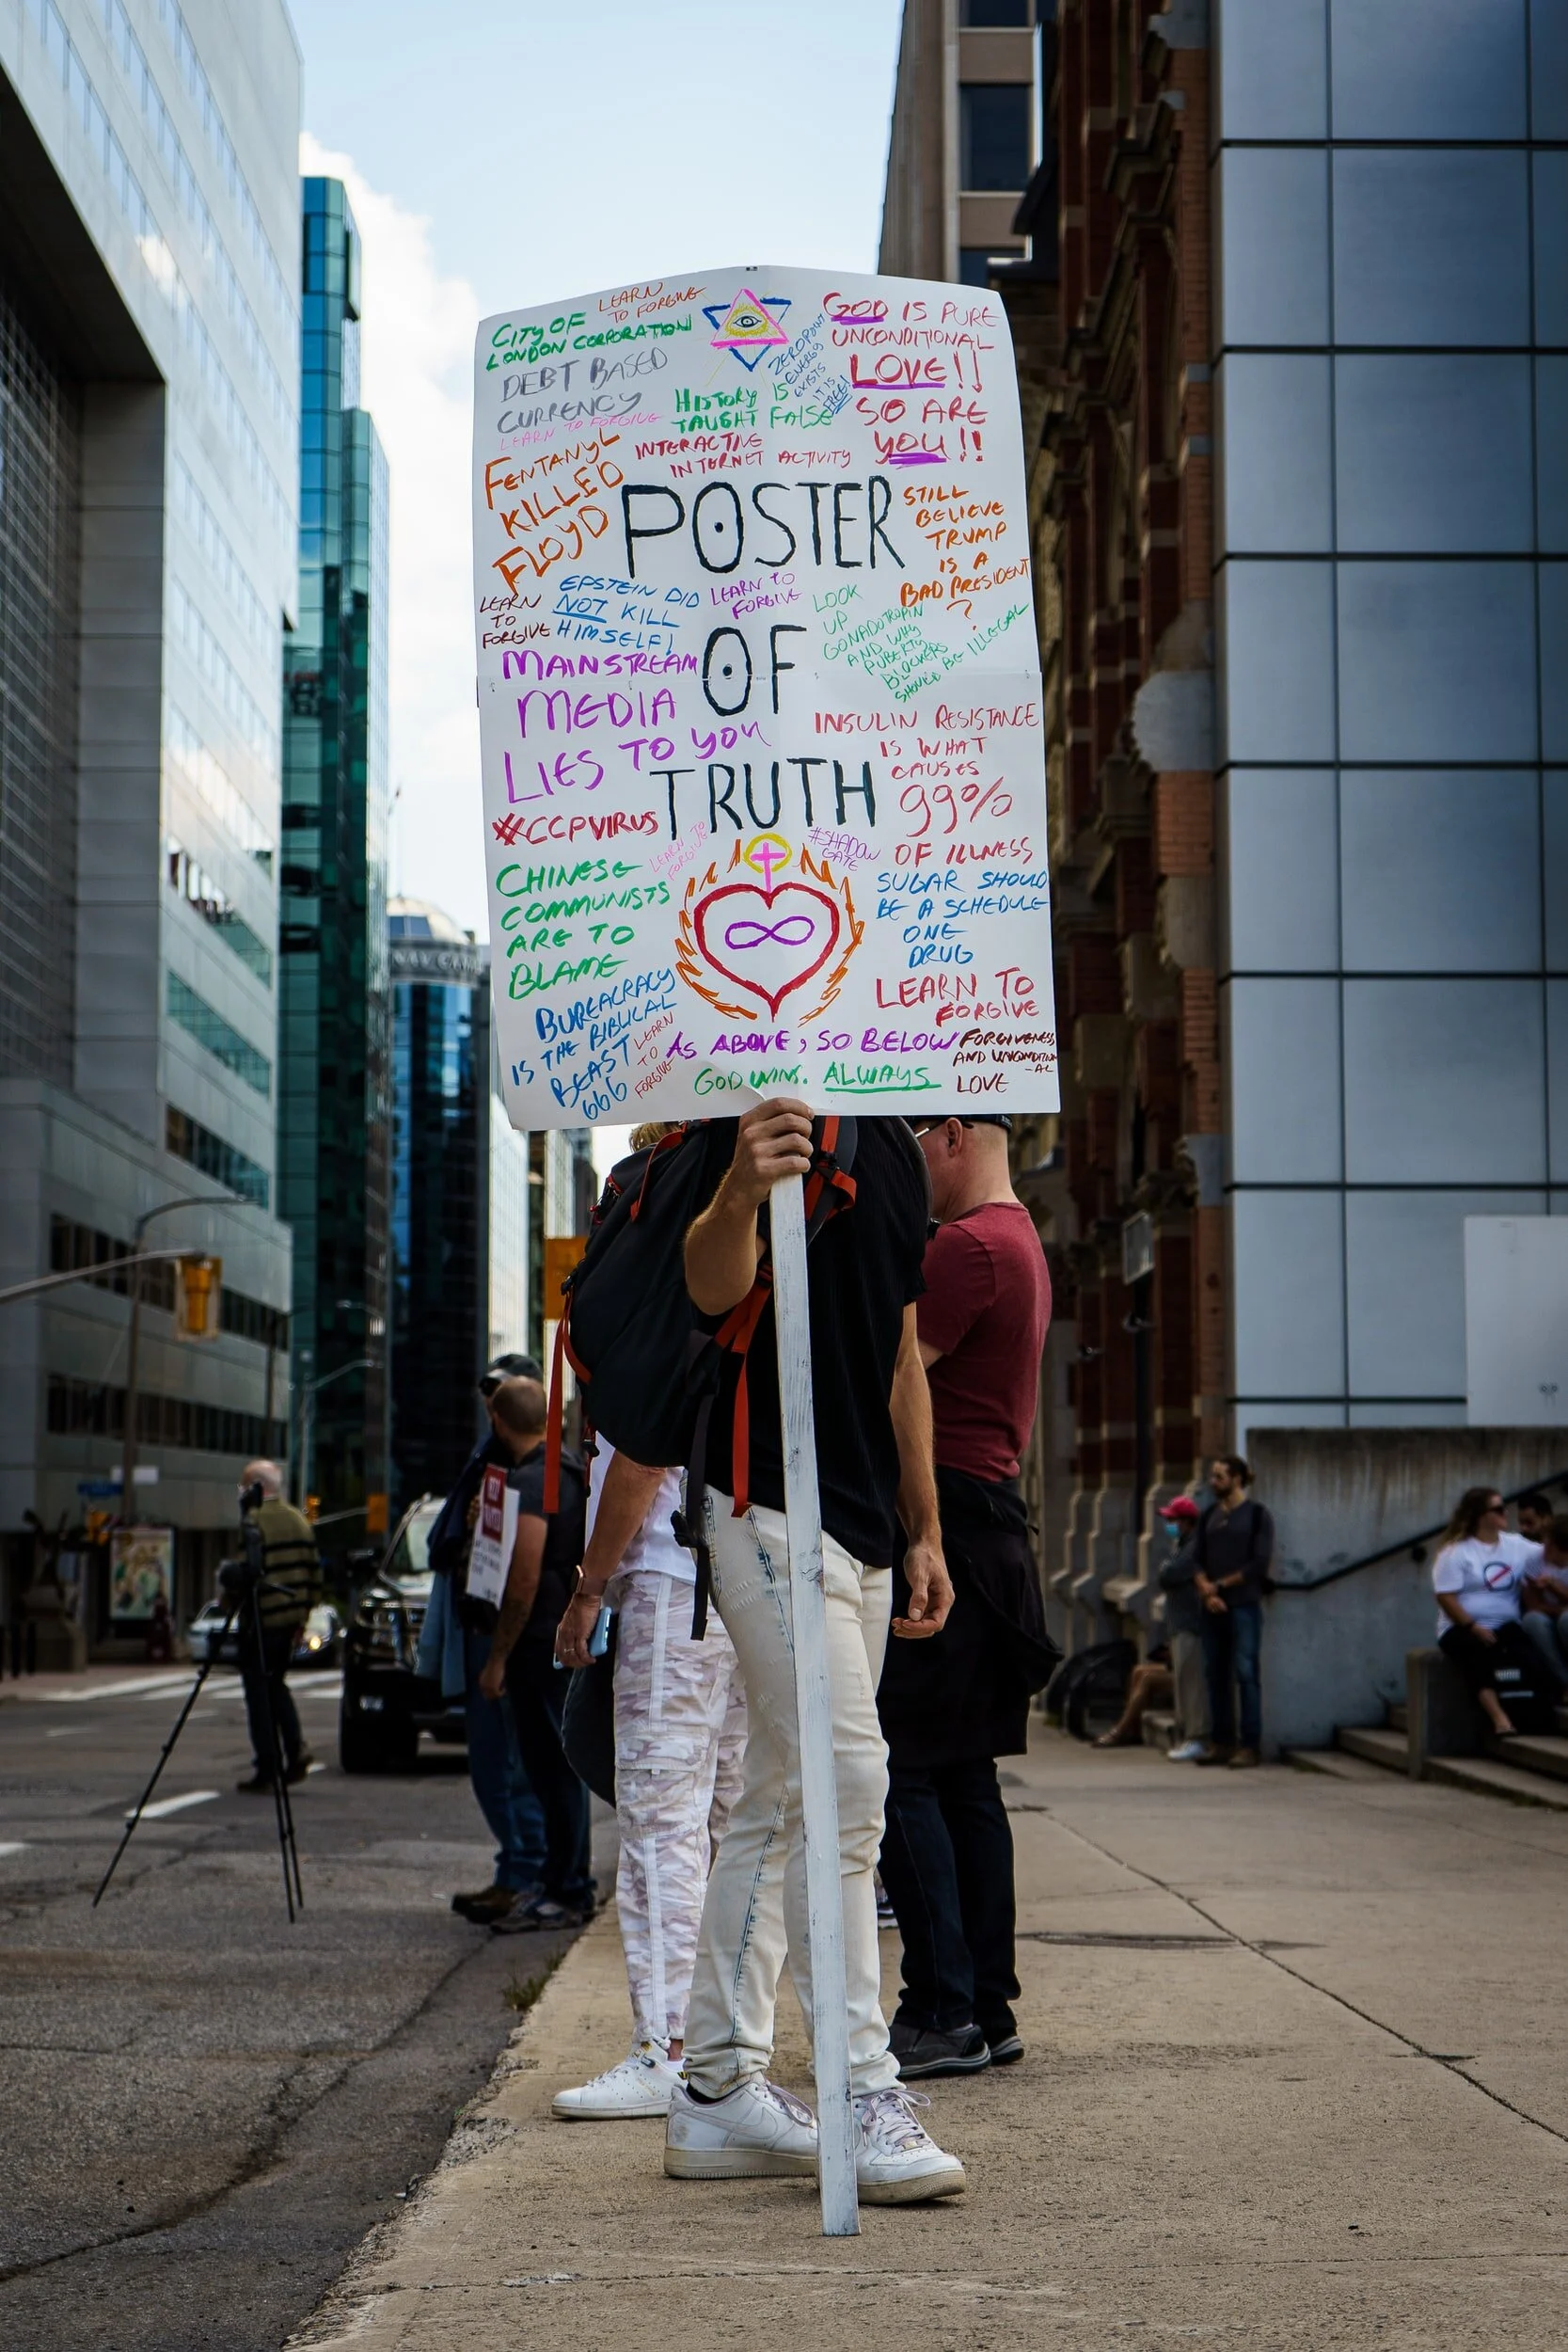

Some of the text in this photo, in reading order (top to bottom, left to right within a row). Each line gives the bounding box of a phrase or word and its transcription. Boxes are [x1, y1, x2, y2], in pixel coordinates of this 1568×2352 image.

[599, 281, 663, 312] LEARN
[608, 286, 707, 324] TO FORGIVE
[823, 292, 1000, 327] GOD IS PURE
[485, 313, 692, 372] LONDON CORPORATION
[492, 311, 587, 348] CITY OF
[832, 326, 994, 349] UNCONDITIONAL
[500, 346, 668, 403] DEBT BASED
[784, 342, 824, 384] ENERGY
[674, 382, 789, 414] HISTORY IS
[794, 365, 826, 397] EXISTS
[813, 377, 836, 402] IT IS
[497, 392, 642, 434] CURRENCY
[670, 405, 834, 434] TAUGHT FALSE
[856, 396, 989, 426] SO ARE
[500, 413, 663, 452] LEARN TO FORGIVE
[635, 432, 763, 460] INTERACTIVE
[484, 428, 620, 510] FENTANYL
[670, 450, 851, 478] INTERNET ACTIVITY
[499, 461, 625, 540] KILLED
[902, 485, 970, 507] STILL
[622, 475, 906, 579] POSTER
[915, 501, 1005, 529] BELIEVE
[491, 505, 609, 596] FLOYD
[925, 520, 1007, 551] TRUMP
[939, 551, 989, 574] IS A
[559, 575, 700, 608] EPSTEIN DID
[710, 578, 764, 606] LEARN
[813, 583, 863, 613] LOOK
[900, 558, 1030, 608] BAD PRESIDENT
[480, 594, 542, 612] LEARN
[556, 594, 681, 628] NOT KILL
[732, 589, 802, 620] FORGIVE
[482, 622, 551, 649] FORGIVE
[490, 613, 516, 628] TO
[557, 619, 673, 656] HIMSELF!
[823, 610, 848, 635] UP
[847, 624, 923, 667] AND WHY
[864, 639, 927, 676] PUBERTY
[895, 602, 1030, 704] SHOULD BE ILLEGAL
[502, 649, 698, 680] MAINSTREAM
[703, 625, 807, 716] OF
[880, 640, 949, 691] BLOCKERS
[516, 688, 677, 739] MEDIA
[815, 703, 1039, 735] INSULIN RESISTANCE
[879, 736, 988, 758] IS WHAT
[504, 750, 604, 803] LIES
[618, 737, 675, 771] TO
[891, 760, 980, 780] CAUSES
[649, 756, 876, 841] TRUTH
[899, 775, 1013, 837] 99%
[492, 811, 659, 846] #CCPVIRUS
[808, 826, 881, 861] #SHADOW
[649, 836, 685, 873] LEARN
[821, 848, 859, 871] GATE
[895, 836, 1033, 867] OF ILLNESS
[496, 859, 643, 898] CHINESE
[877, 868, 1047, 895] SUGAR SHOULD
[500, 881, 671, 931] COMMUNISTS
[876, 894, 1050, 921] BE A SCHEDULE
[506, 923, 635, 959] ARE TO
[903, 923, 968, 944] ONE
[908, 944, 974, 969] DRUG
[509, 952, 629, 1000] BLAME
[876, 966, 1035, 1009] LEARN TO
[935, 999, 1039, 1027] FORGIVE
[512, 994, 677, 1087] IS THE BIBLICAL
[633, 1011, 674, 1050] LEARN
[666, 1030, 698, 1059] AS
[816, 1029, 853, 1054] SO
[861, 1027, 960, 1054] BELOW
[959, 1028, 1055, 1048] FORGIVENESS
[550, 1033, 630, 1109] BEAST
[637, 1046, 658, 1067] TO
[952, 1049, 987, 1067] AND
[633, 1056, 676, 1099] FORGIVE
[693, 1068, 743, 1096] GOD
[823, 1060, 931, 1088] ALWAYS
[957, 1073, 1010, 1094] LOVE
[582, 1076, 627, 1120] 666
